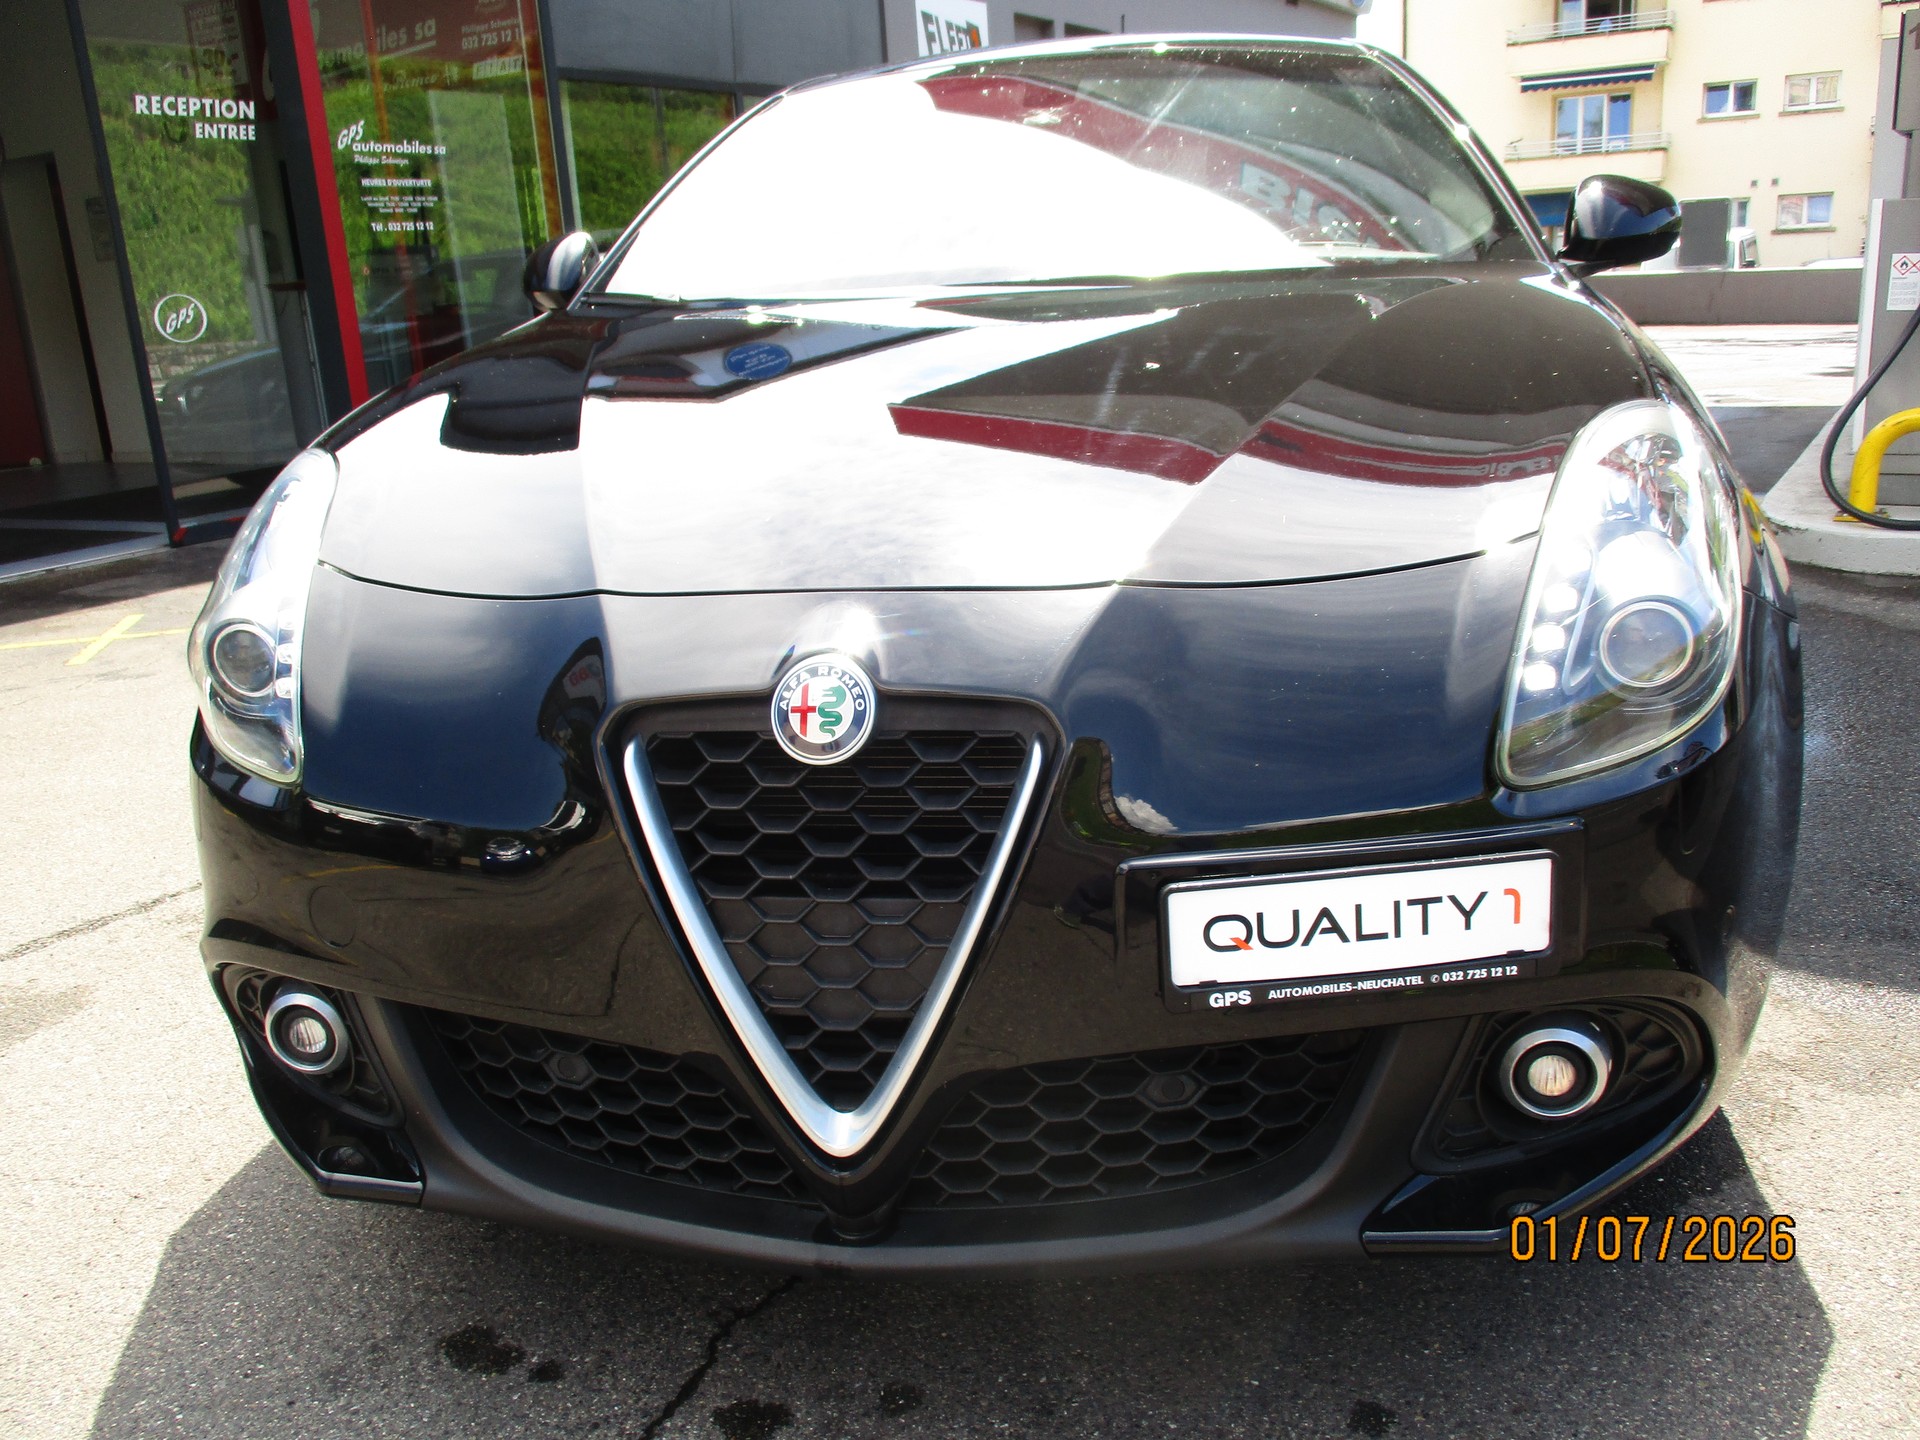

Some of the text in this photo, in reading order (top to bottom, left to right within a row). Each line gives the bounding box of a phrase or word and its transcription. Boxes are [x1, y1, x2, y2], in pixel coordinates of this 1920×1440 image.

[134, 94, 256, 120] RECEPTION
[194, 122, 256, 141] ENTREE
[338, 120, 365, 149] GPS
[353, 140, 447, 155] automobiles sa
[166, 303, 195, 334] GPS
[779, 665, 866, 711] ALFA ROMEO
[1203, 891, 1488, 952] QUALITY
[1209, 965, 1518, 1008] GPS AUTOMOBILES-NEUCHATEL 032 725 12 12
